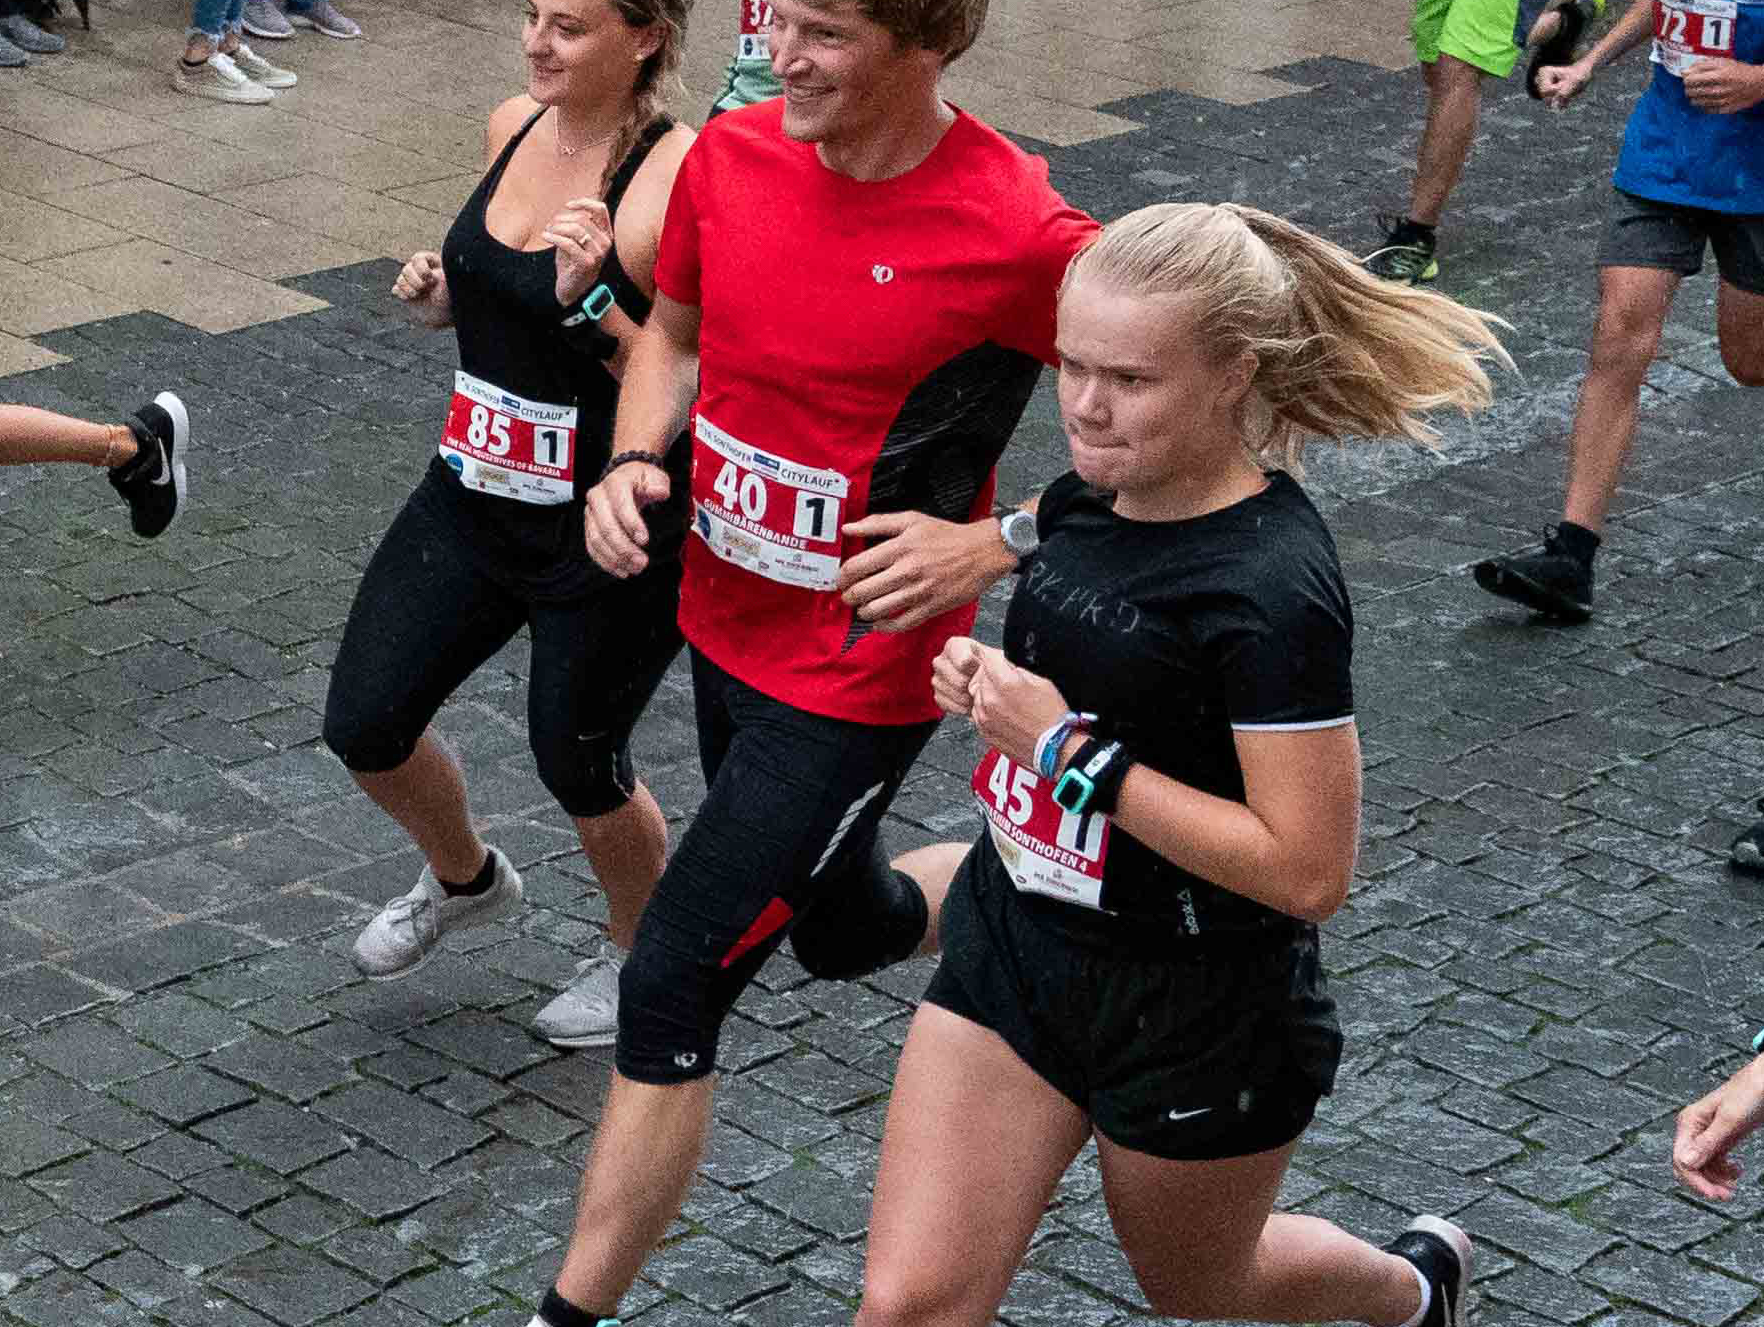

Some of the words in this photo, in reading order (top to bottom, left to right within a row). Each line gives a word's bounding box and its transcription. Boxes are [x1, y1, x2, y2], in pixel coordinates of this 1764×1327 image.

[1710, 20, 1722, 46] 1
[520, 408, 564, 421] CITYLAUF
[467, 404, 511, 456] 85
[541, 430, 558, 464] 1
[528, 463, 561, 478] BAVARIA
[781, 468, 835, 489] CITYLAUF
[713, 460, 767, 522] 40
[806, 497, 826, 537] 1
[988, 753, 1039, 825] 45
[1010, 828, 1078, 869] SONTHOFEN
[1080, 860, 1089, 873] 4
